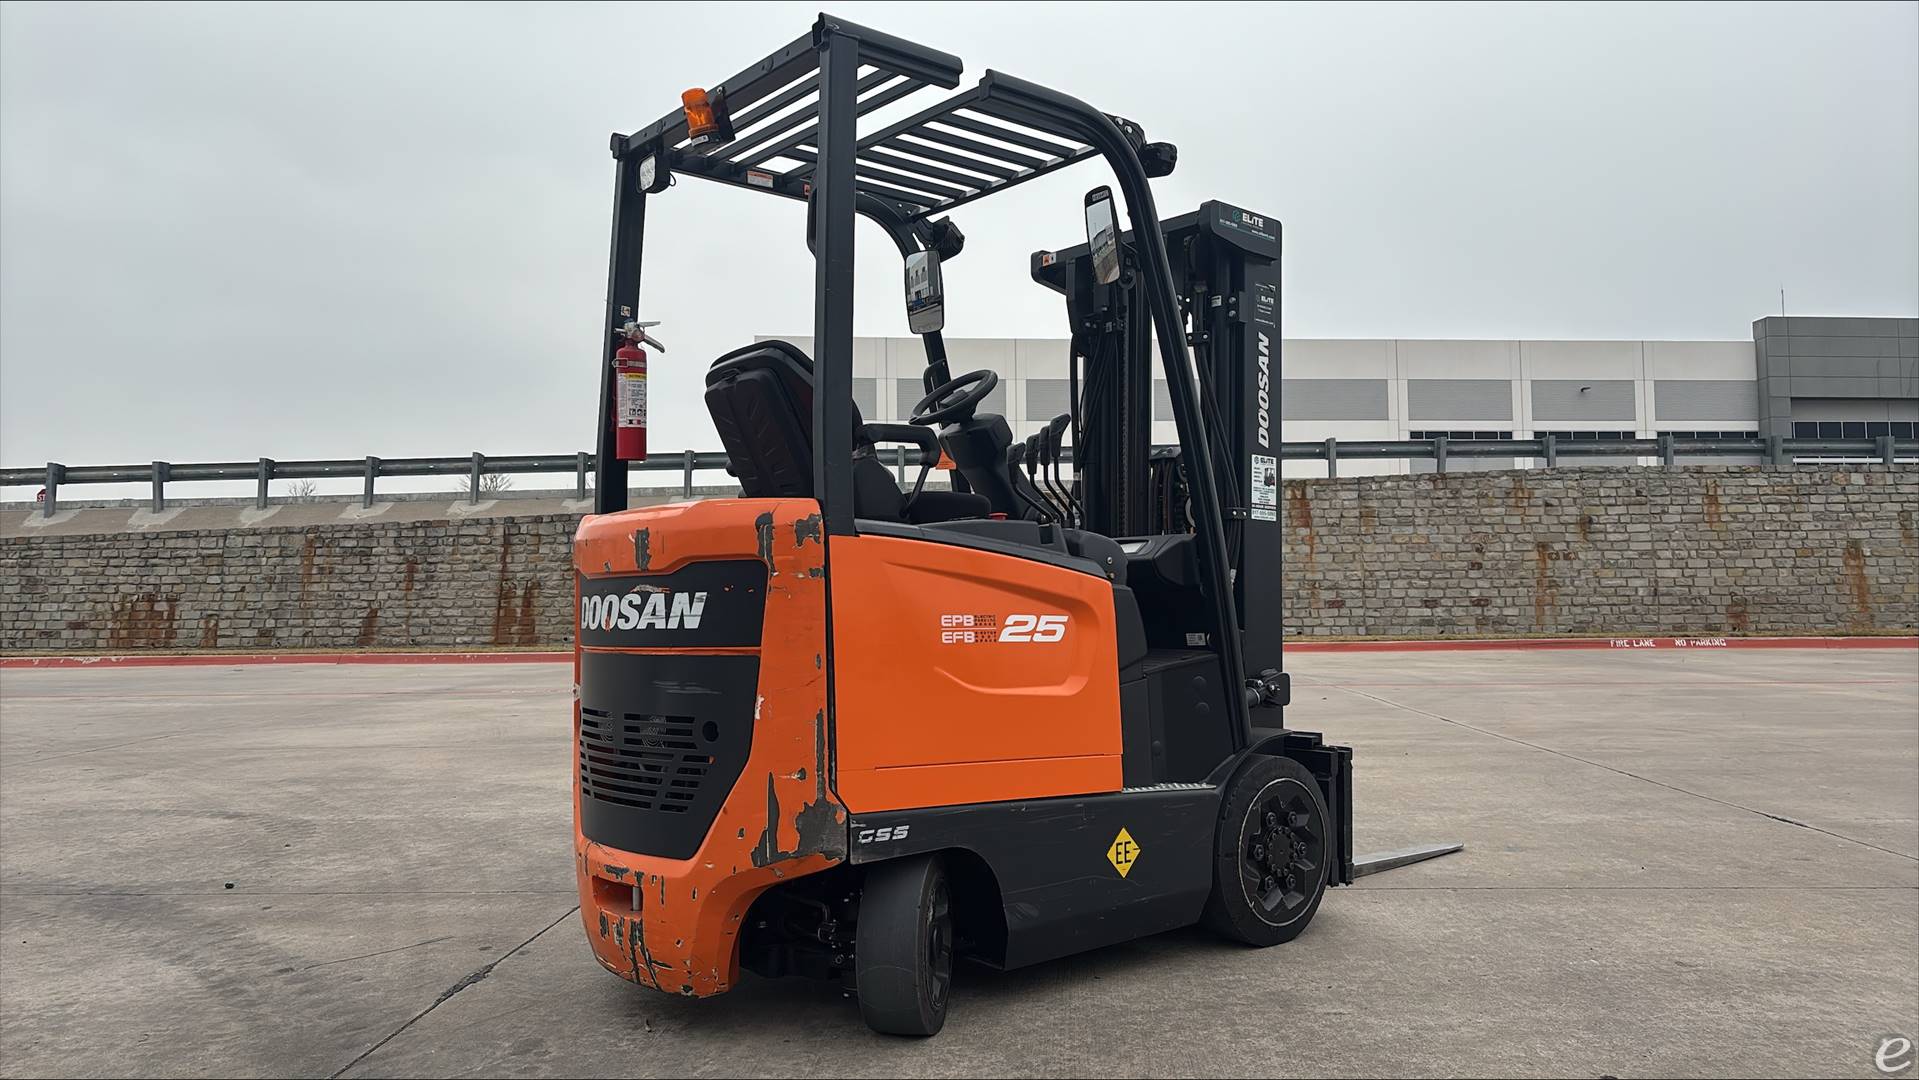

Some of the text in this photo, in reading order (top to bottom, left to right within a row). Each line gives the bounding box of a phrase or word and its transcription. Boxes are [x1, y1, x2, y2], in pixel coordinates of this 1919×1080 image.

[1242, 212, 1264, 228] ELITE
[1258, 331, 1270, 448] DOOSAN
[581, 591, 708, 630] DOOSAN
[941, 614, 975, 626] EPB
[941, 631, 976, 644] EFB
[998, 614, 1069, 642] 25
[1610, 638, 1727, 647] FIRE LANE NO PARKING
[1115, 841, 1132, 865] EE
